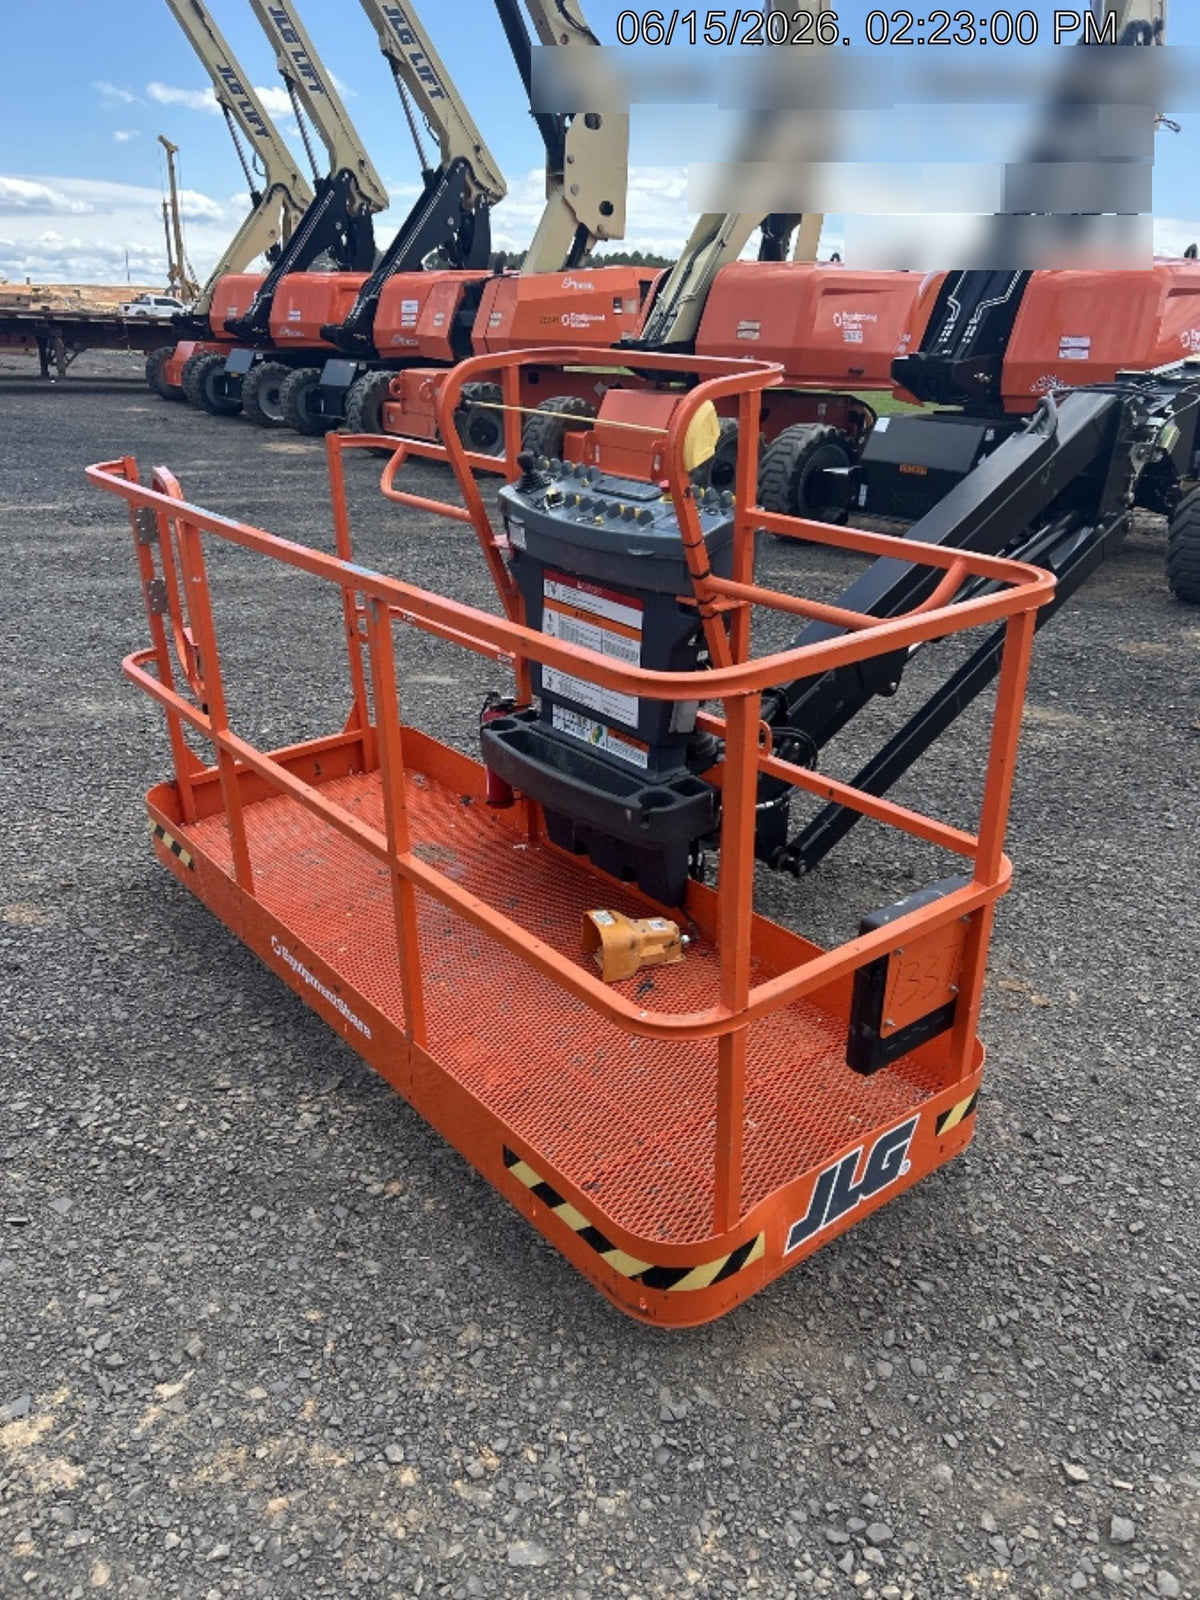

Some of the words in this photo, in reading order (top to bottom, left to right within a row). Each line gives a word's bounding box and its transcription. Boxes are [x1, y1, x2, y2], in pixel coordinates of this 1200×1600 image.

[268, 5, 300, 43] JLG
[291, 50, 325, 94] LIFT
[382, 4, 416, 46] JLG
[408, 52, 445, 99] LIFT
[215, 63, 245, 95] JLG
[237, 100, 271, 138] LIFT
[783, 1112, 921, 1257] JLG
